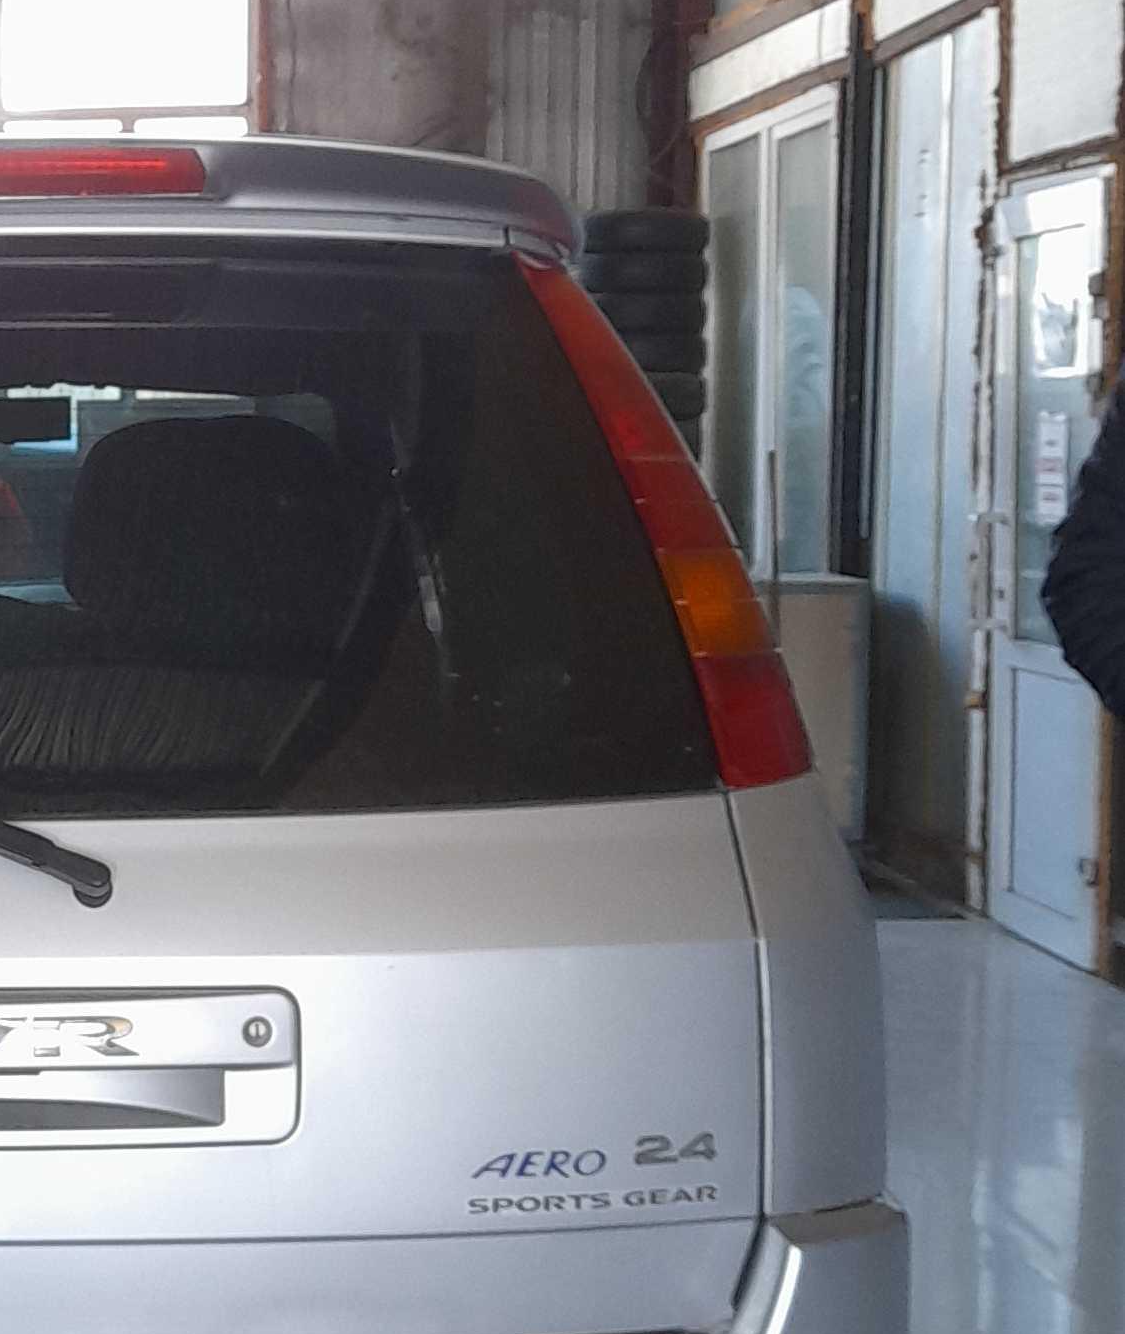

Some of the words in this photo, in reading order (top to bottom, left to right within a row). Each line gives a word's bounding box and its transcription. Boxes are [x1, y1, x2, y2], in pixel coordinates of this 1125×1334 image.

[471, 1149, 607, 1179] AERO
[467, 1192, 611, 1215] SPORTS
[622, 1184, 719, 1208] GEAR
